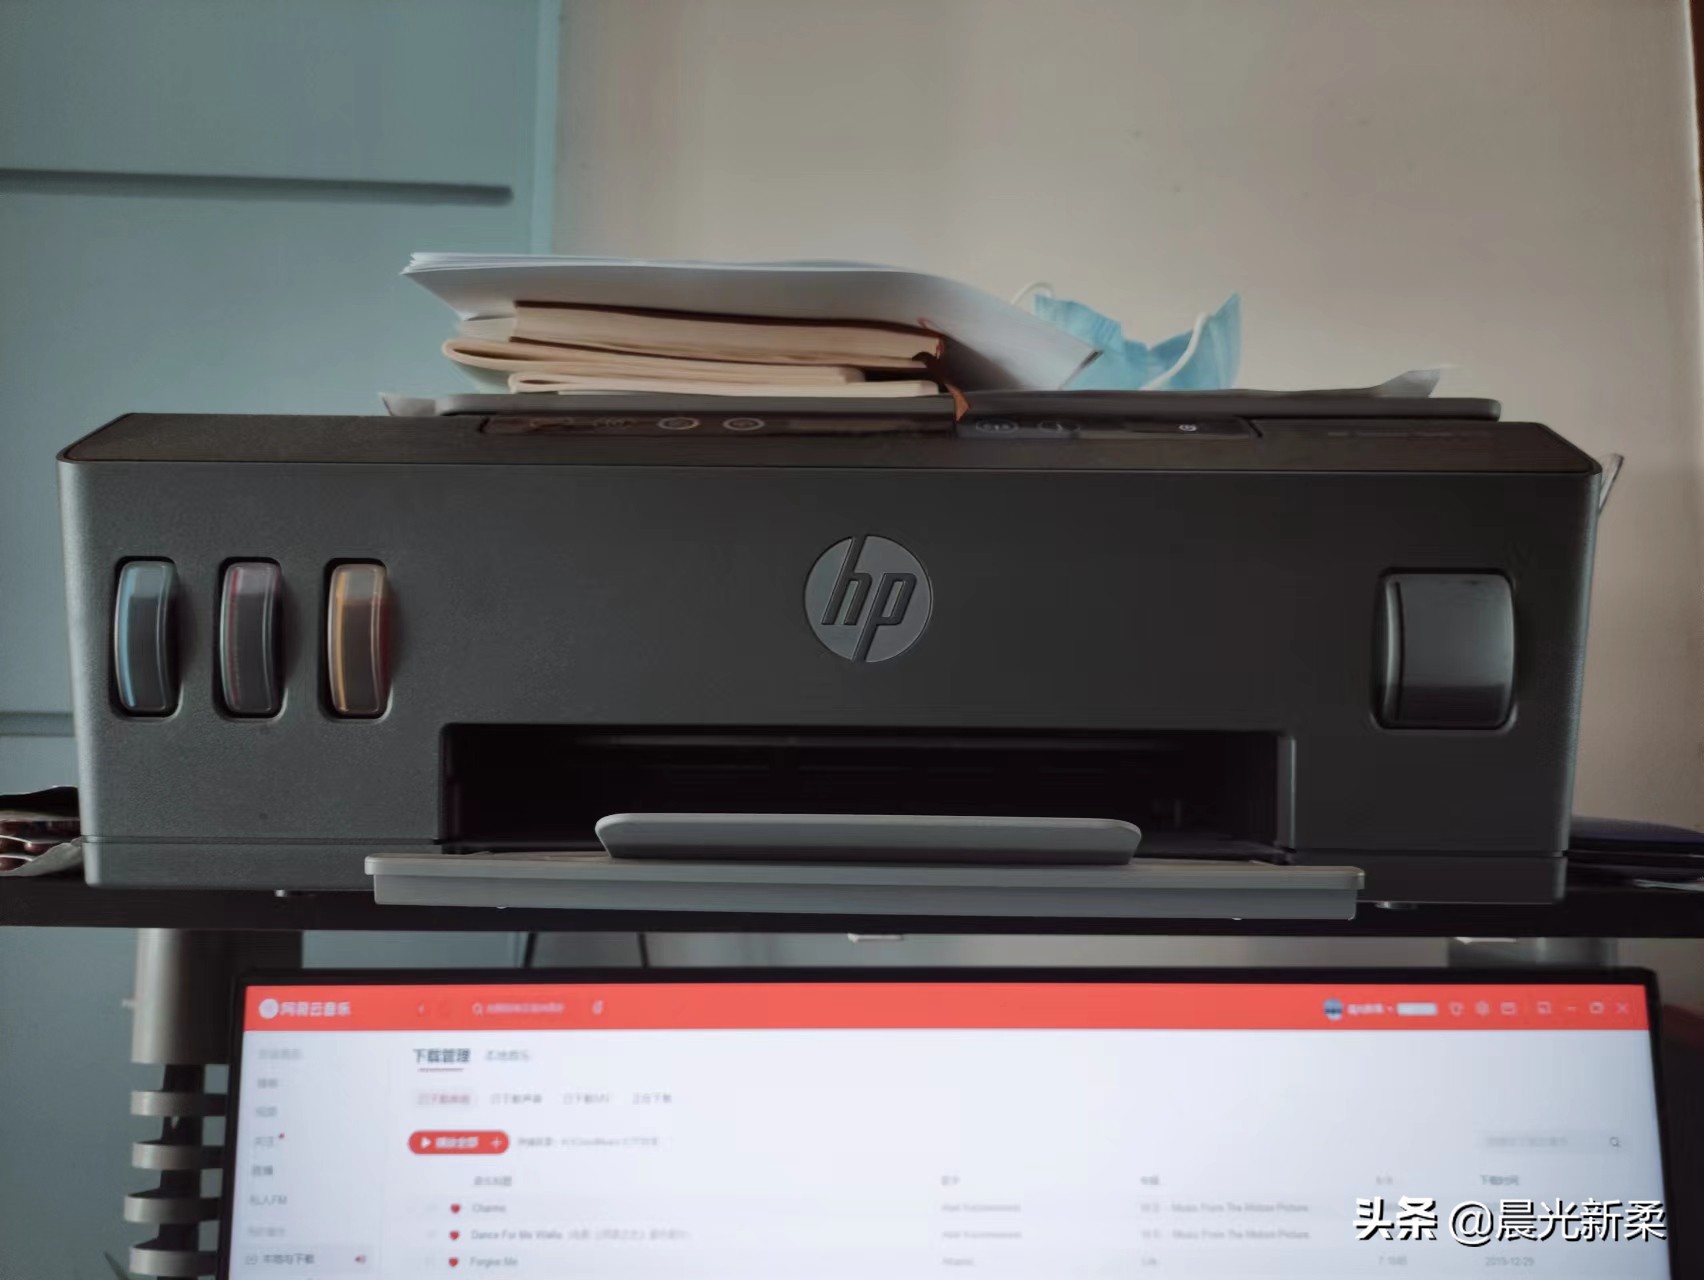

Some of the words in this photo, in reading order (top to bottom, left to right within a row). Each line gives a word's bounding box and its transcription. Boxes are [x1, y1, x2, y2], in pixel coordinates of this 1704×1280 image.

[819, 535, 918, 661] hp
[412, 1047, 471, 1064] 下载管理
